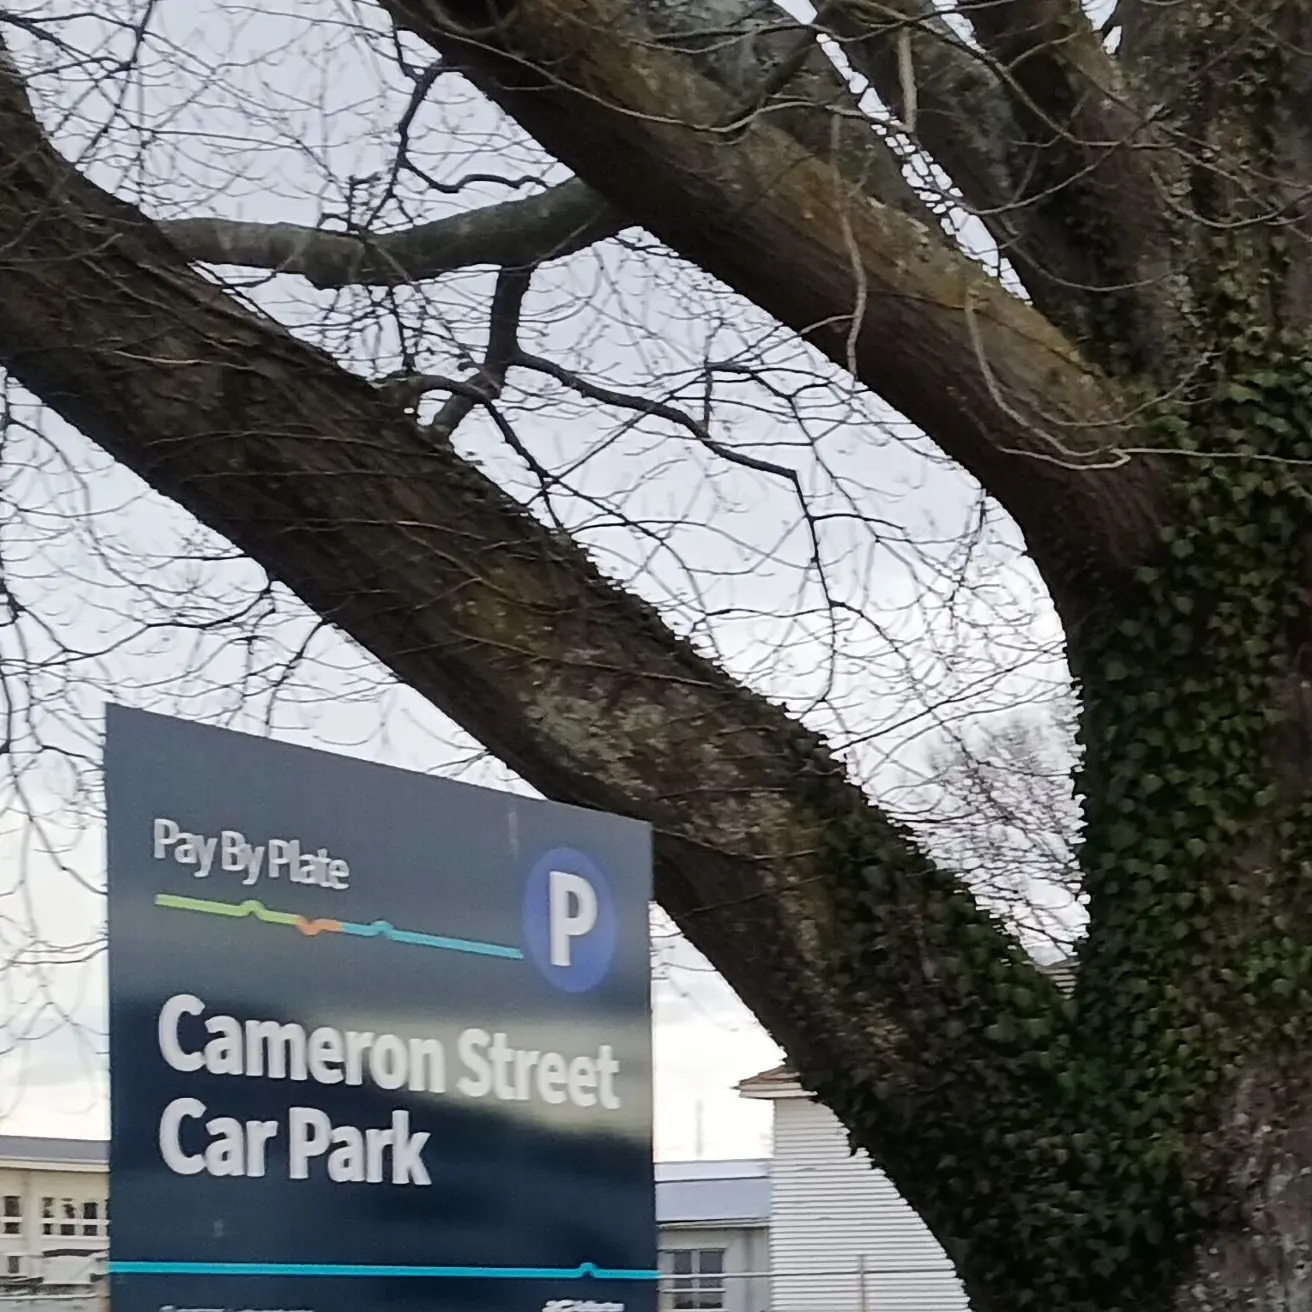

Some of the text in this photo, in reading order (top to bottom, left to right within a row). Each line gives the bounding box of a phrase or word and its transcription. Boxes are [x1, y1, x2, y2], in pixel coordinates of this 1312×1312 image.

[154, 818, 350, 890] Pay By Plate
[549, 871, 598, 966] P
[158, 994, 622, 1109] Cameron Street
[158, 1098, 432, 1186] Car Park
